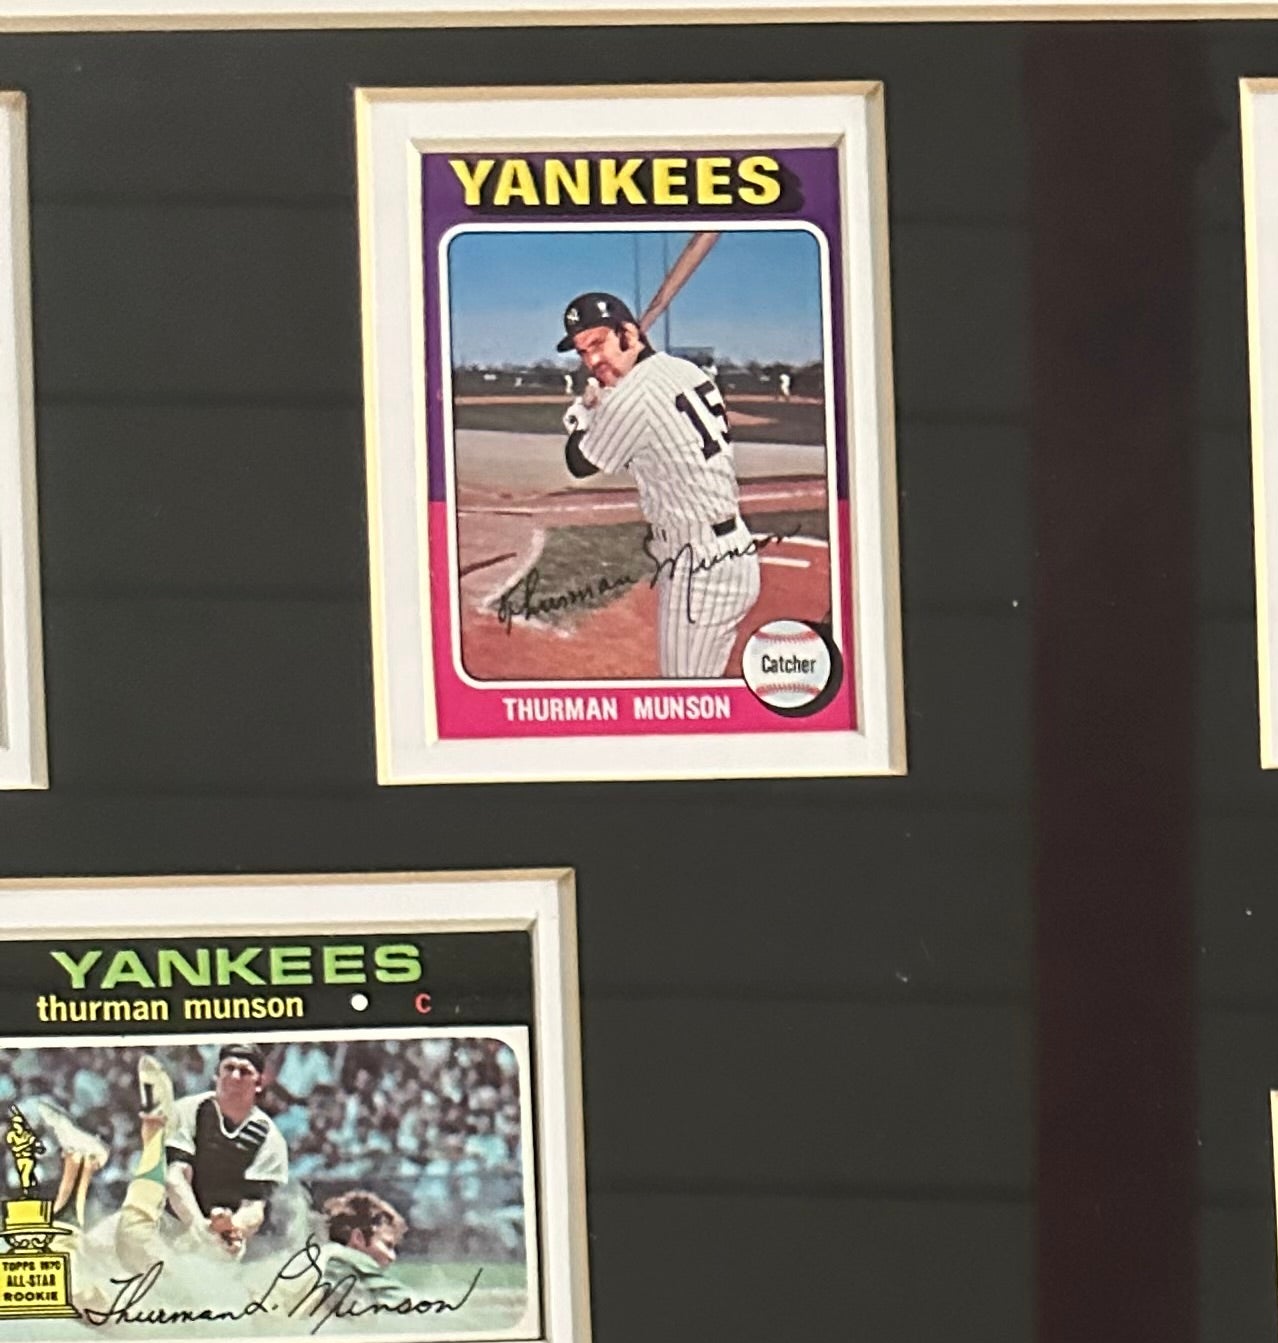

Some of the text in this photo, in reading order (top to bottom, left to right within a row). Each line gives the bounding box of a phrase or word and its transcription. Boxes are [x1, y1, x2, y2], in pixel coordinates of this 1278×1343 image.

[449, 155, 782, 206] YANKEES
[761, 654, 816, 674] Catcher
[502, 694, 731, 721] THURMAN MUNSON
[51, 944, 423, 989] YANKEES
[37, 995, 169, 1022] thurman
[184, 992, 304, 1019] munson
[2, 1261, 35, 1271] TOPPS
[7, 1274, 56, 1287] ALL-STAR
[4, 1291, 58, 1301] ROOKIE
